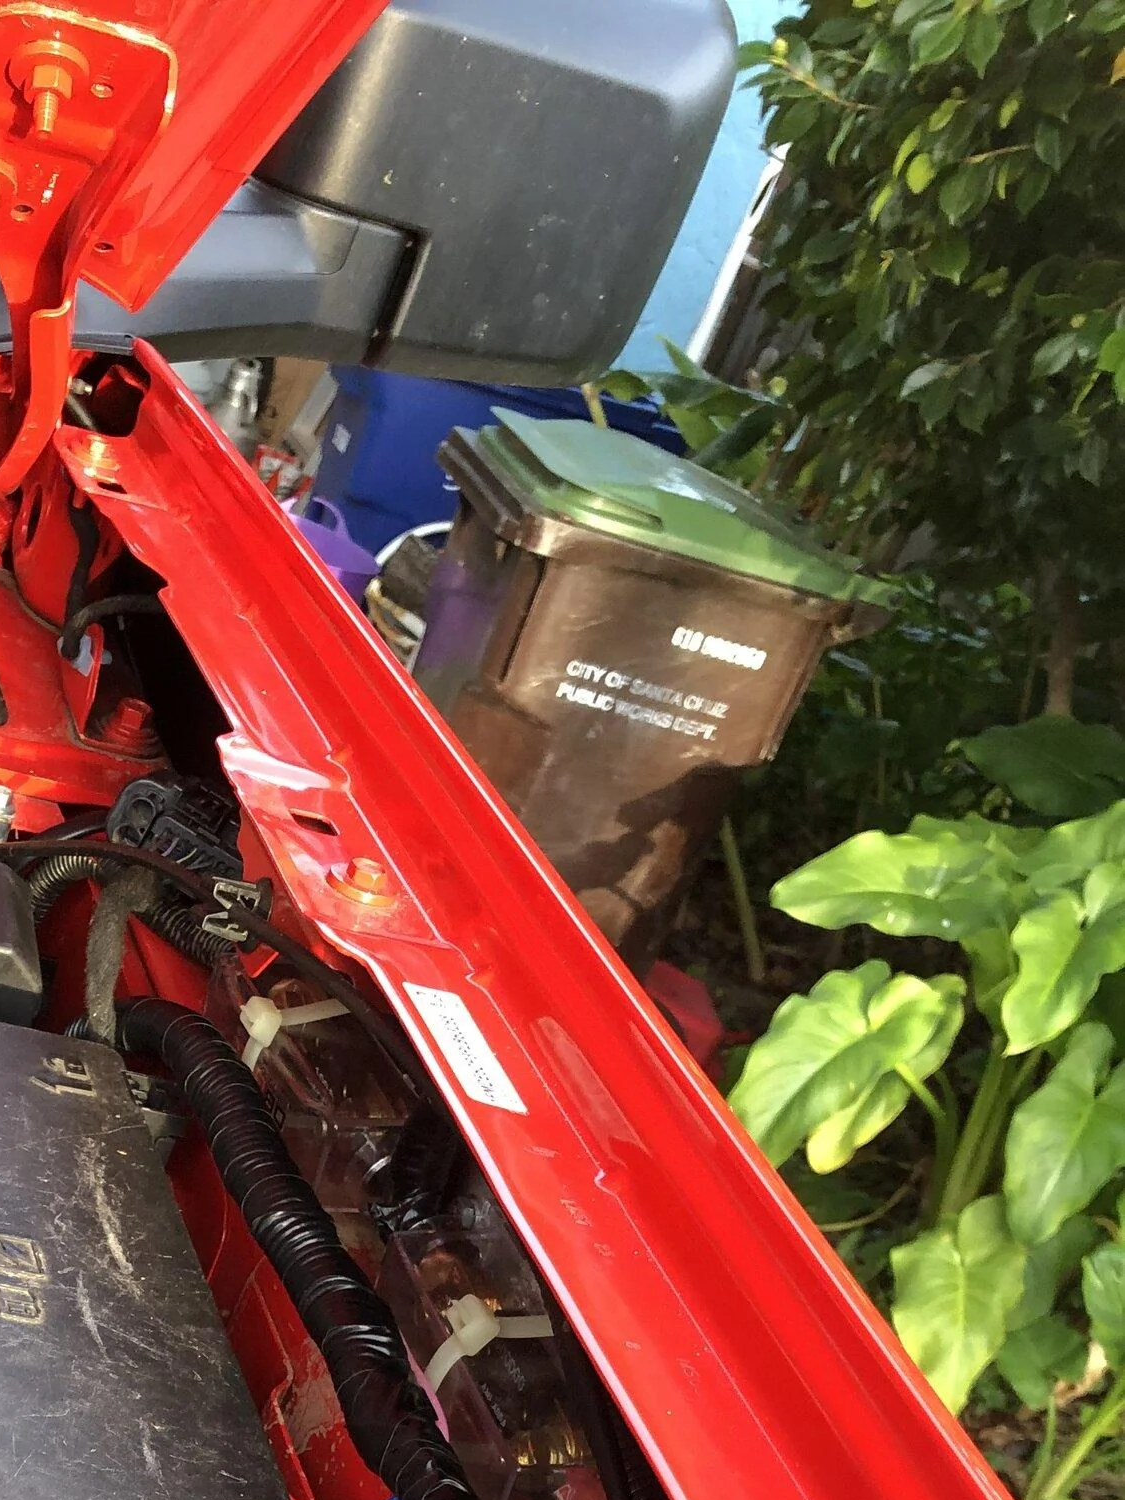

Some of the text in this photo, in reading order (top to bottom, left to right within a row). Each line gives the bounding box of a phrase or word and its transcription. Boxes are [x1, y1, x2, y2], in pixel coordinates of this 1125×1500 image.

[555, 681, 616, 712] PUBLIC
[614, 699, 674, 729] WORKS
[565, 659, 731, 719] CITY OF SANTA CRUZ
